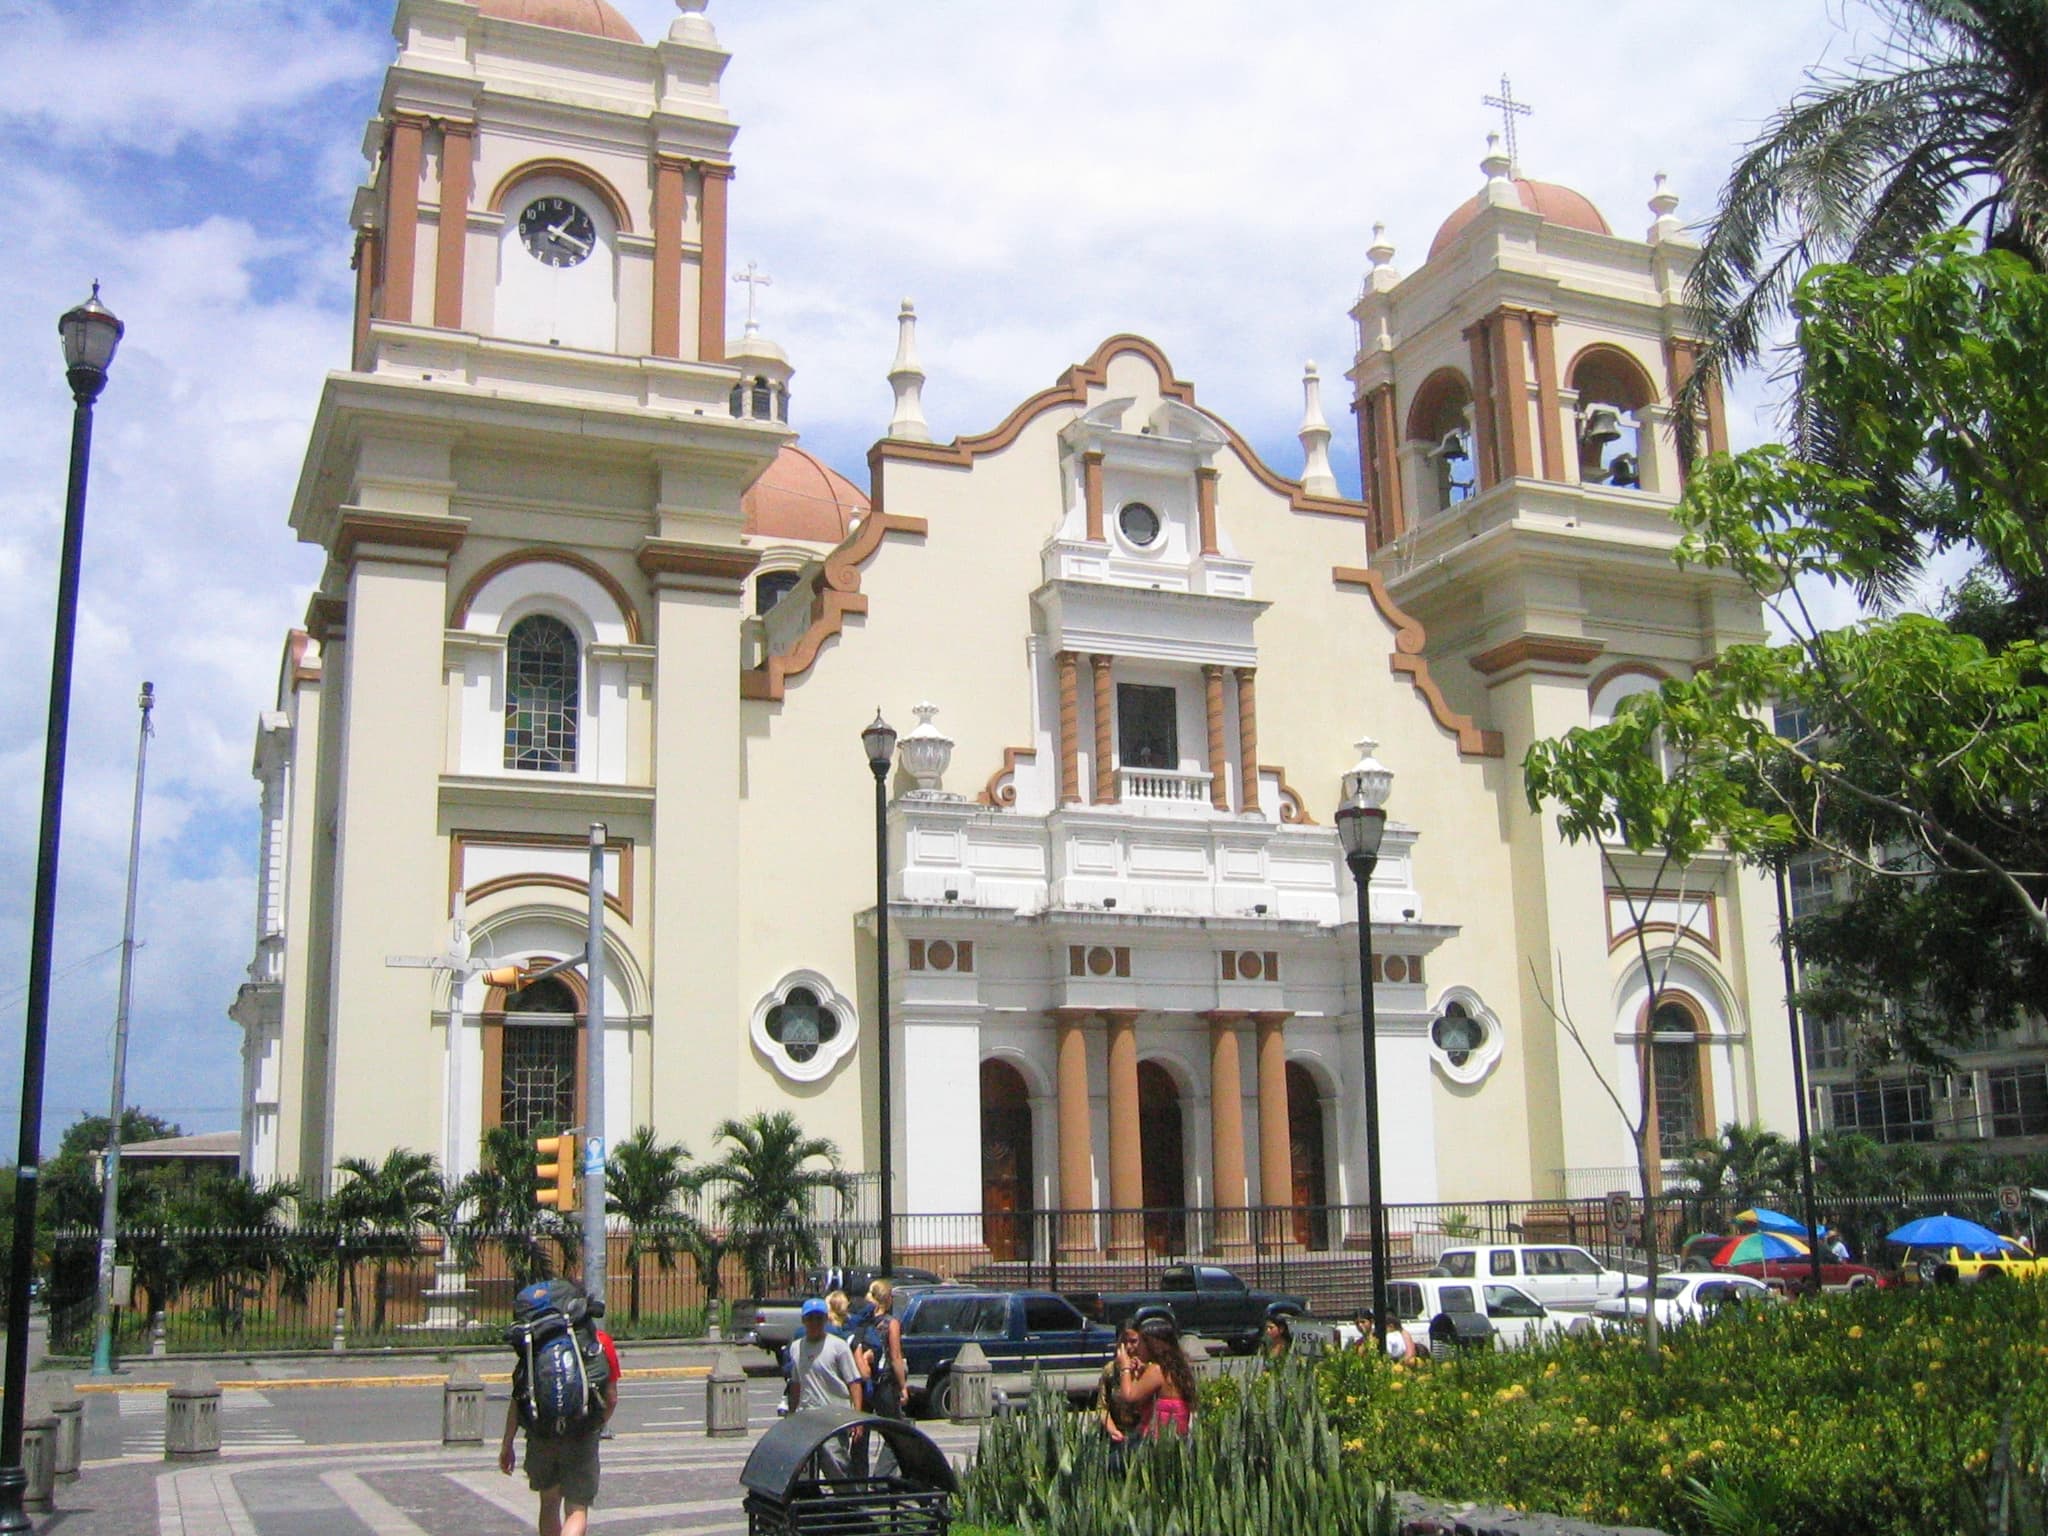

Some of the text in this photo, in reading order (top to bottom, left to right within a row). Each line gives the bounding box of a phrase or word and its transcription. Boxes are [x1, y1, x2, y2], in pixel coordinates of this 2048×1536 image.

[538, 201, 546, 211] 11
[553, 200, 563, 210] 12
[526, 209, 537, 220] 10
[583, 217, 589, 228] 2
[520, 223, 527, 234] 9
[552, 257, 560, 268] 6
[569, 256, 577, 266] 5
